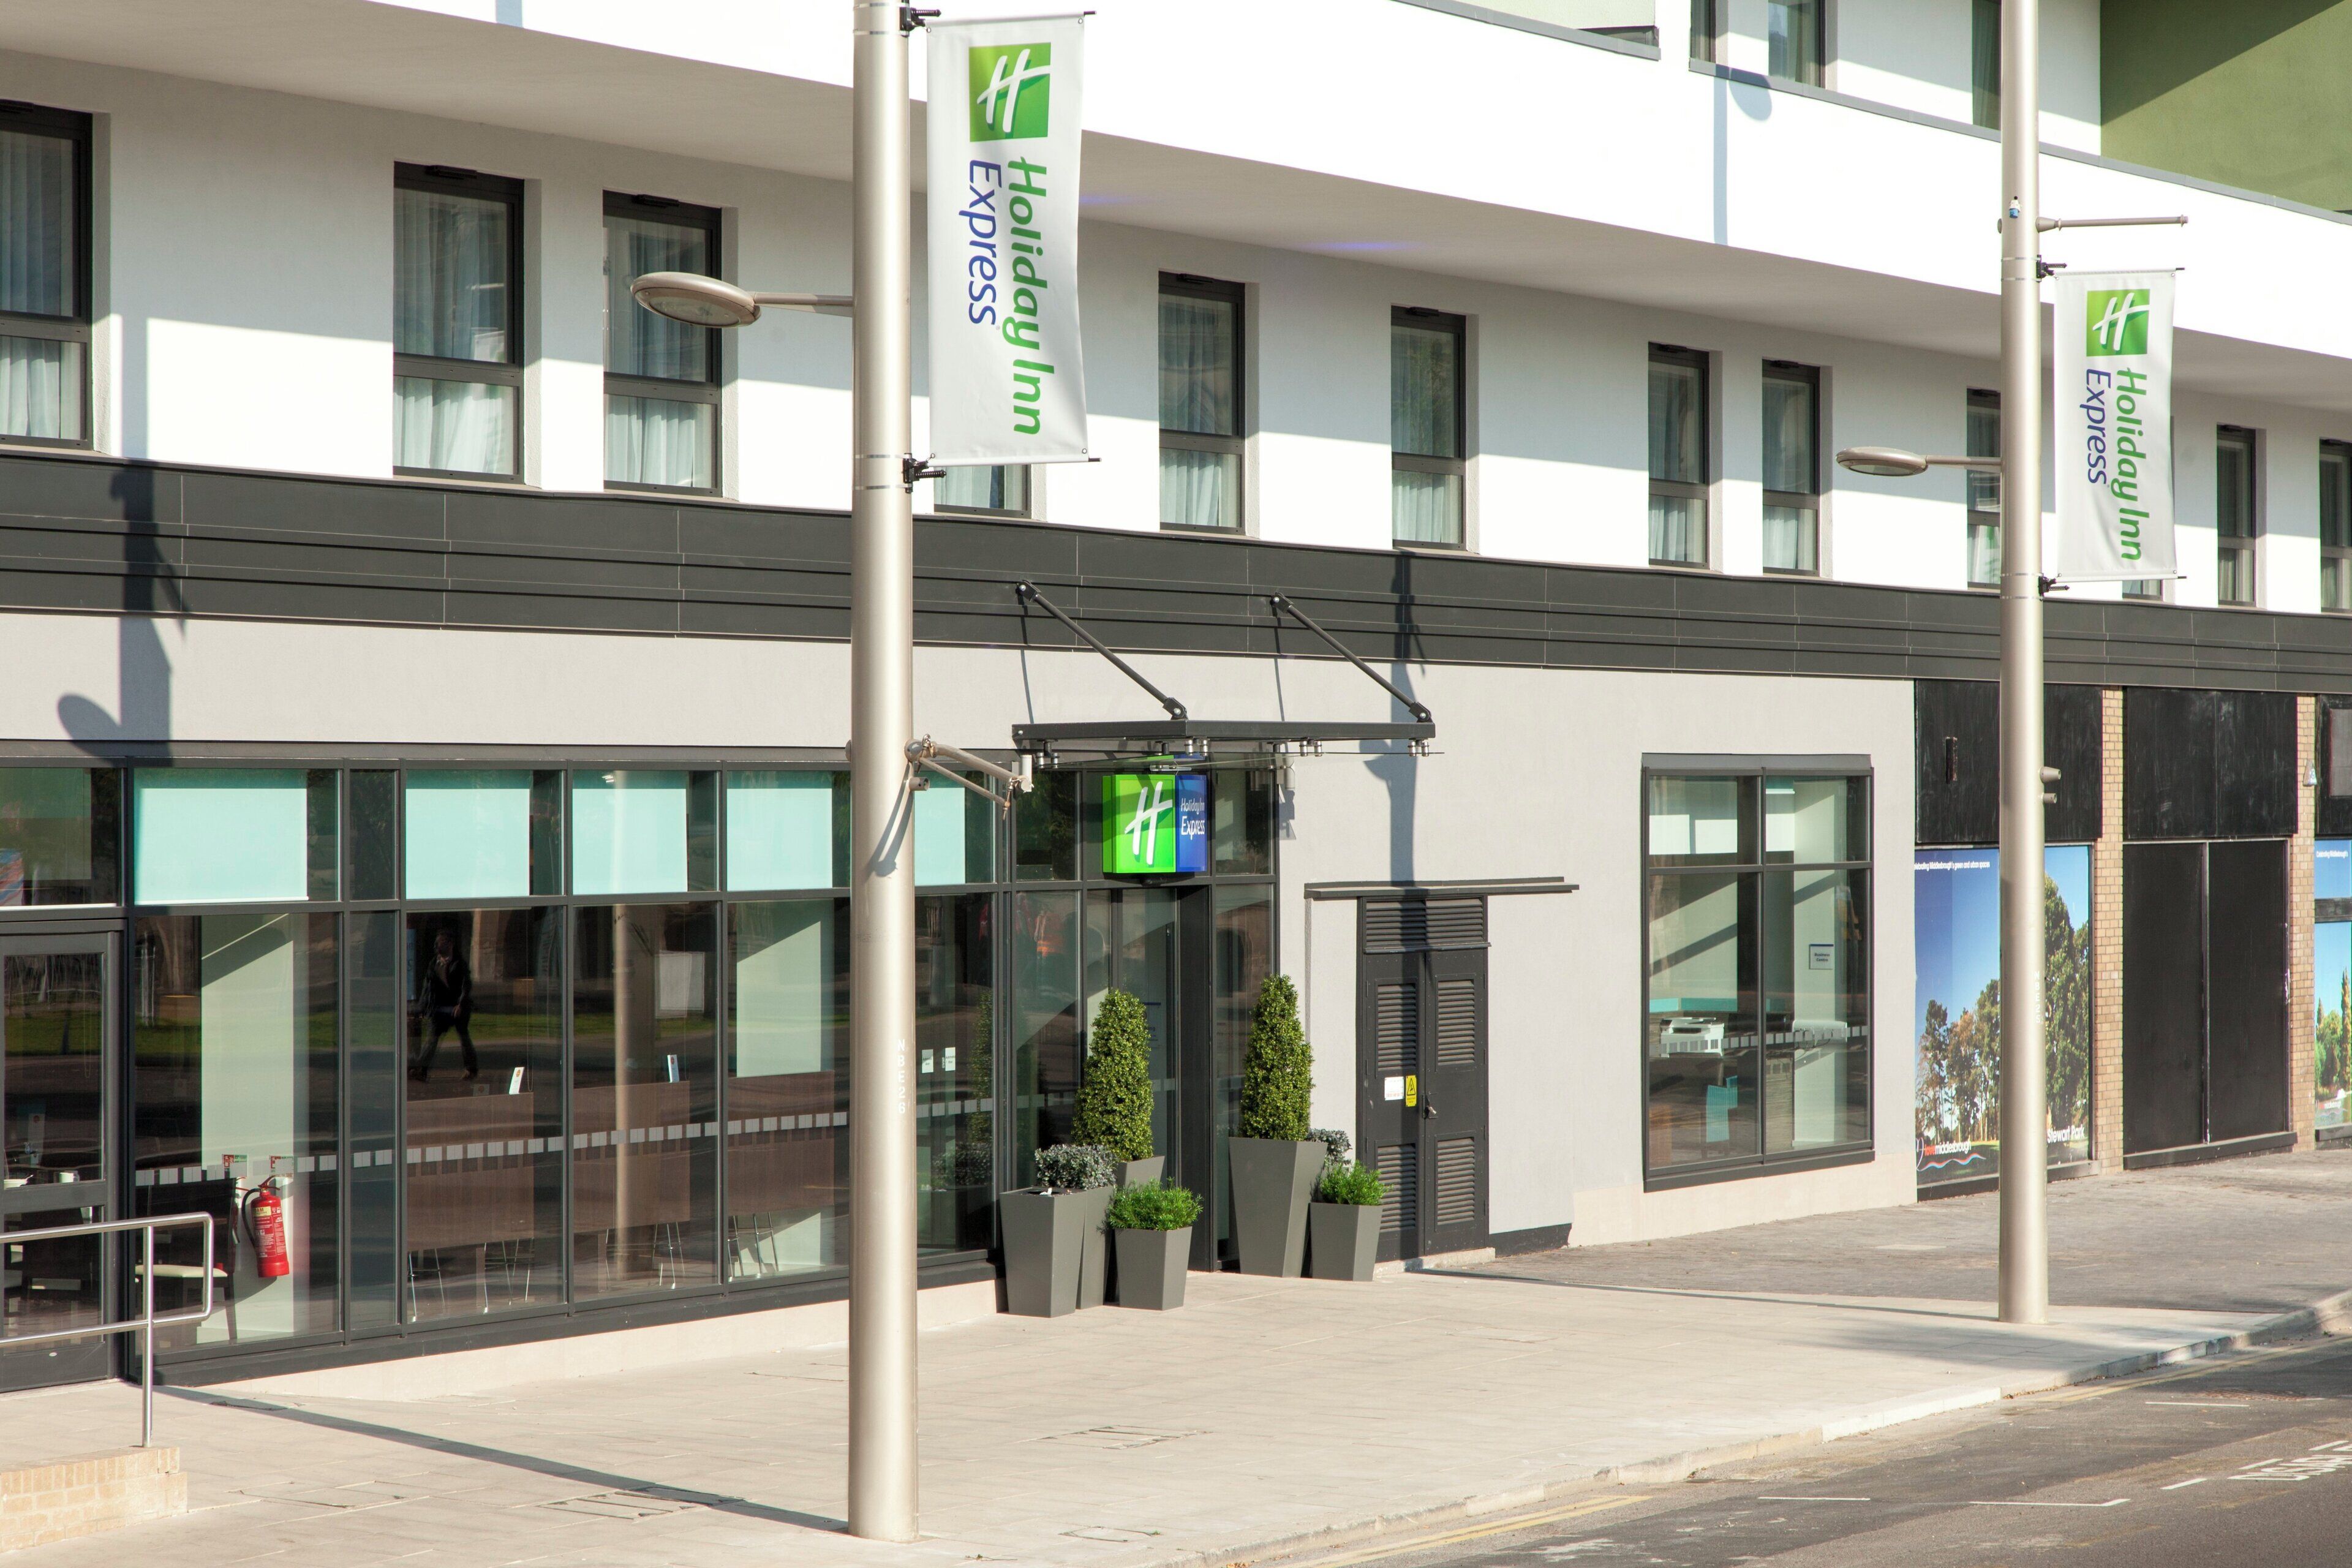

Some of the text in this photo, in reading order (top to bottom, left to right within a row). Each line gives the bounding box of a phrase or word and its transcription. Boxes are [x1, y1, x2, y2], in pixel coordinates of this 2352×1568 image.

[959, 159, 1001, 325] Express
[1002, 156, 1055, 434] Holiday Inn
[2079, 368, 2111, 484] Express
[2111, 367, 2150, 560] Holiday Inn
[1180, 797, 1199, 815] Holiday
[1181, 815, 1205, 840] Express
[1914, 862, 1929, 872] elebrating
[897, 1038, 906, 1114] NBE26
[2047, 1124, 2085, 1144] Stewart Park
